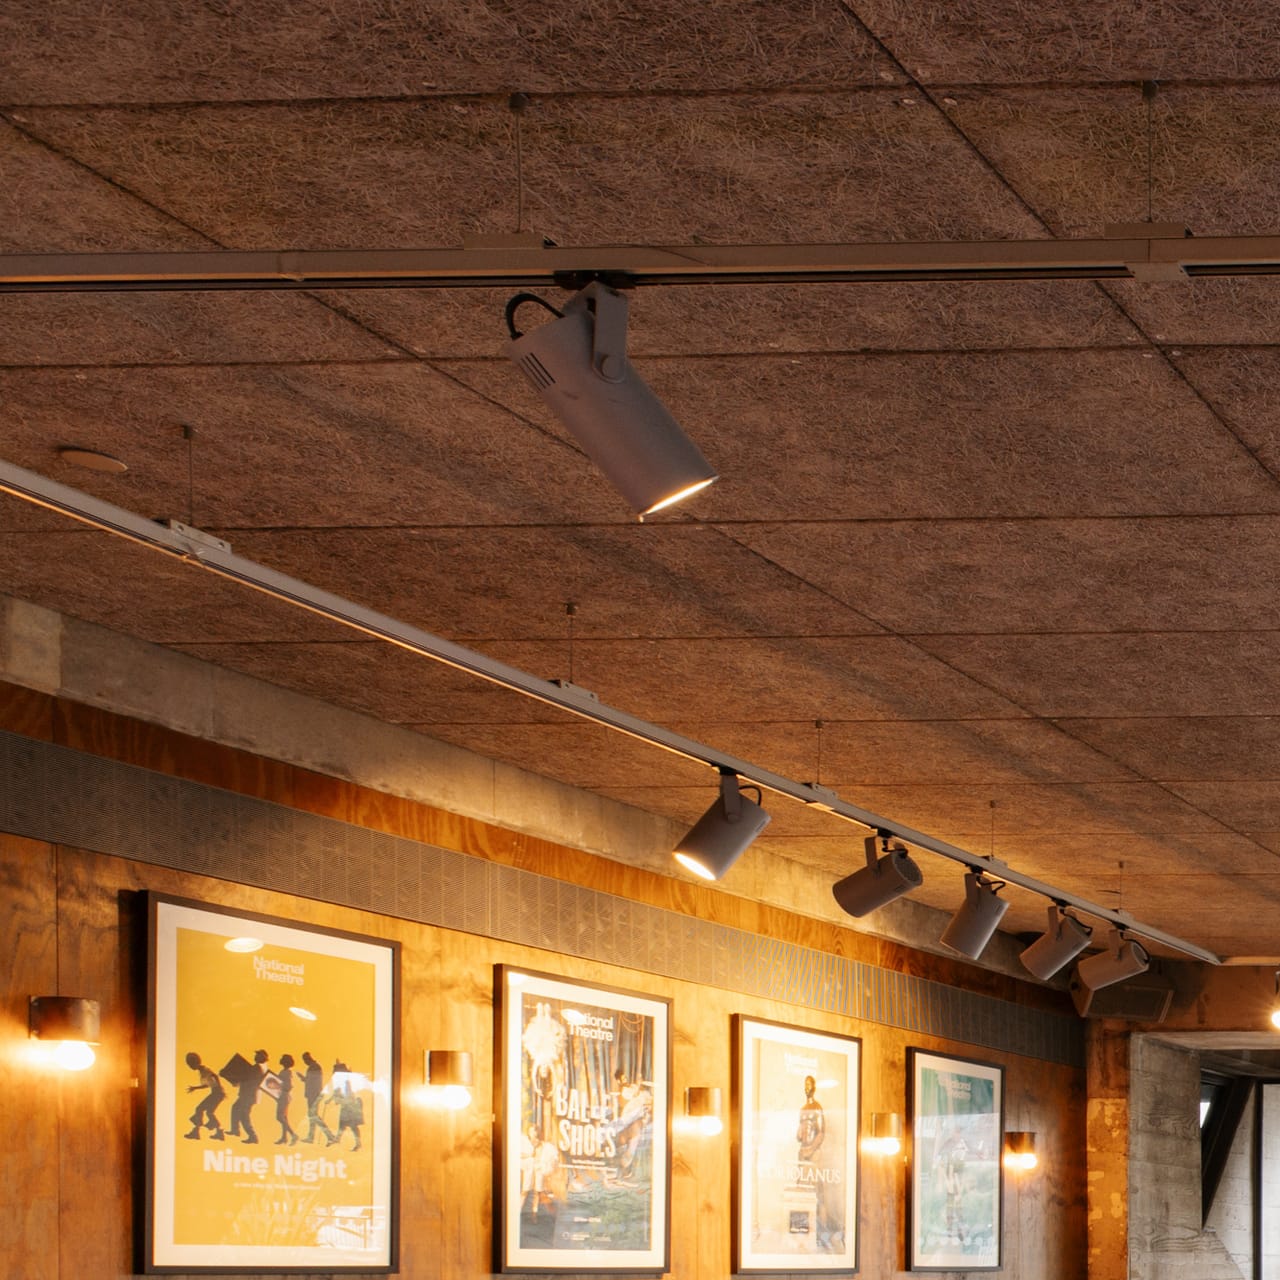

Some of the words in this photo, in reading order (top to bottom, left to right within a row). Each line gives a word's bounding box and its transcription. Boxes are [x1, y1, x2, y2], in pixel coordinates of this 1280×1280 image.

[253, 955, 304, 975] National
[256, 968, 304, 986] Theatre
[570, 1022, 614, 1042] Theatre
[555, 1083, 621, 1124] BALLET
[558, 1118, 617, 1158] SHOES
[203, 1149, 269, 1175] Nine
[273, 1153, 348, 1183] Night
